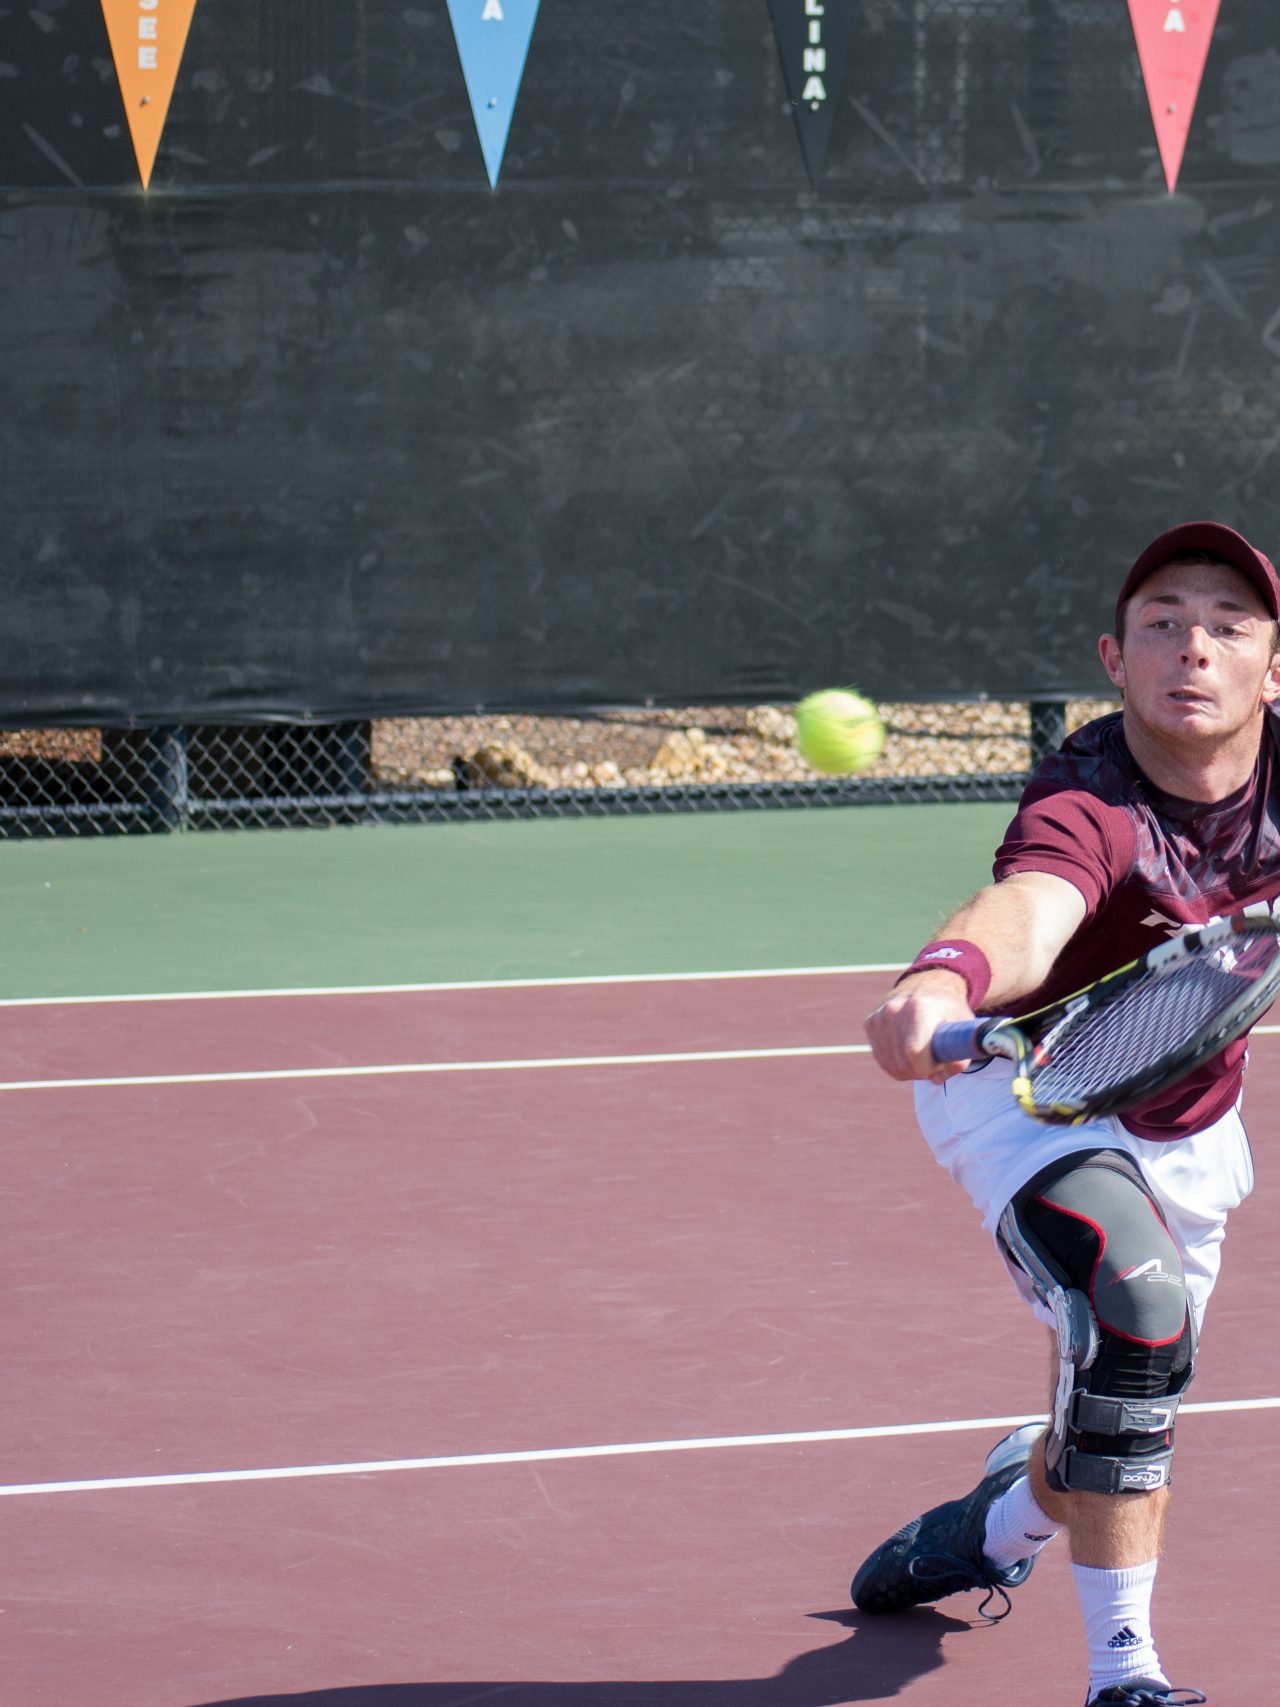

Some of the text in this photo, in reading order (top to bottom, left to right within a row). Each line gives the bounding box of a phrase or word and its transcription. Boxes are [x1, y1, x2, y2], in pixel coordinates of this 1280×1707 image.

[1162, 0, 1185, 32] A
[802, 0, 826, 100] LINA
[1122, 1471, 1161, 1484] DONJOY
[1107, 1635, 1143, 1649] adidas
